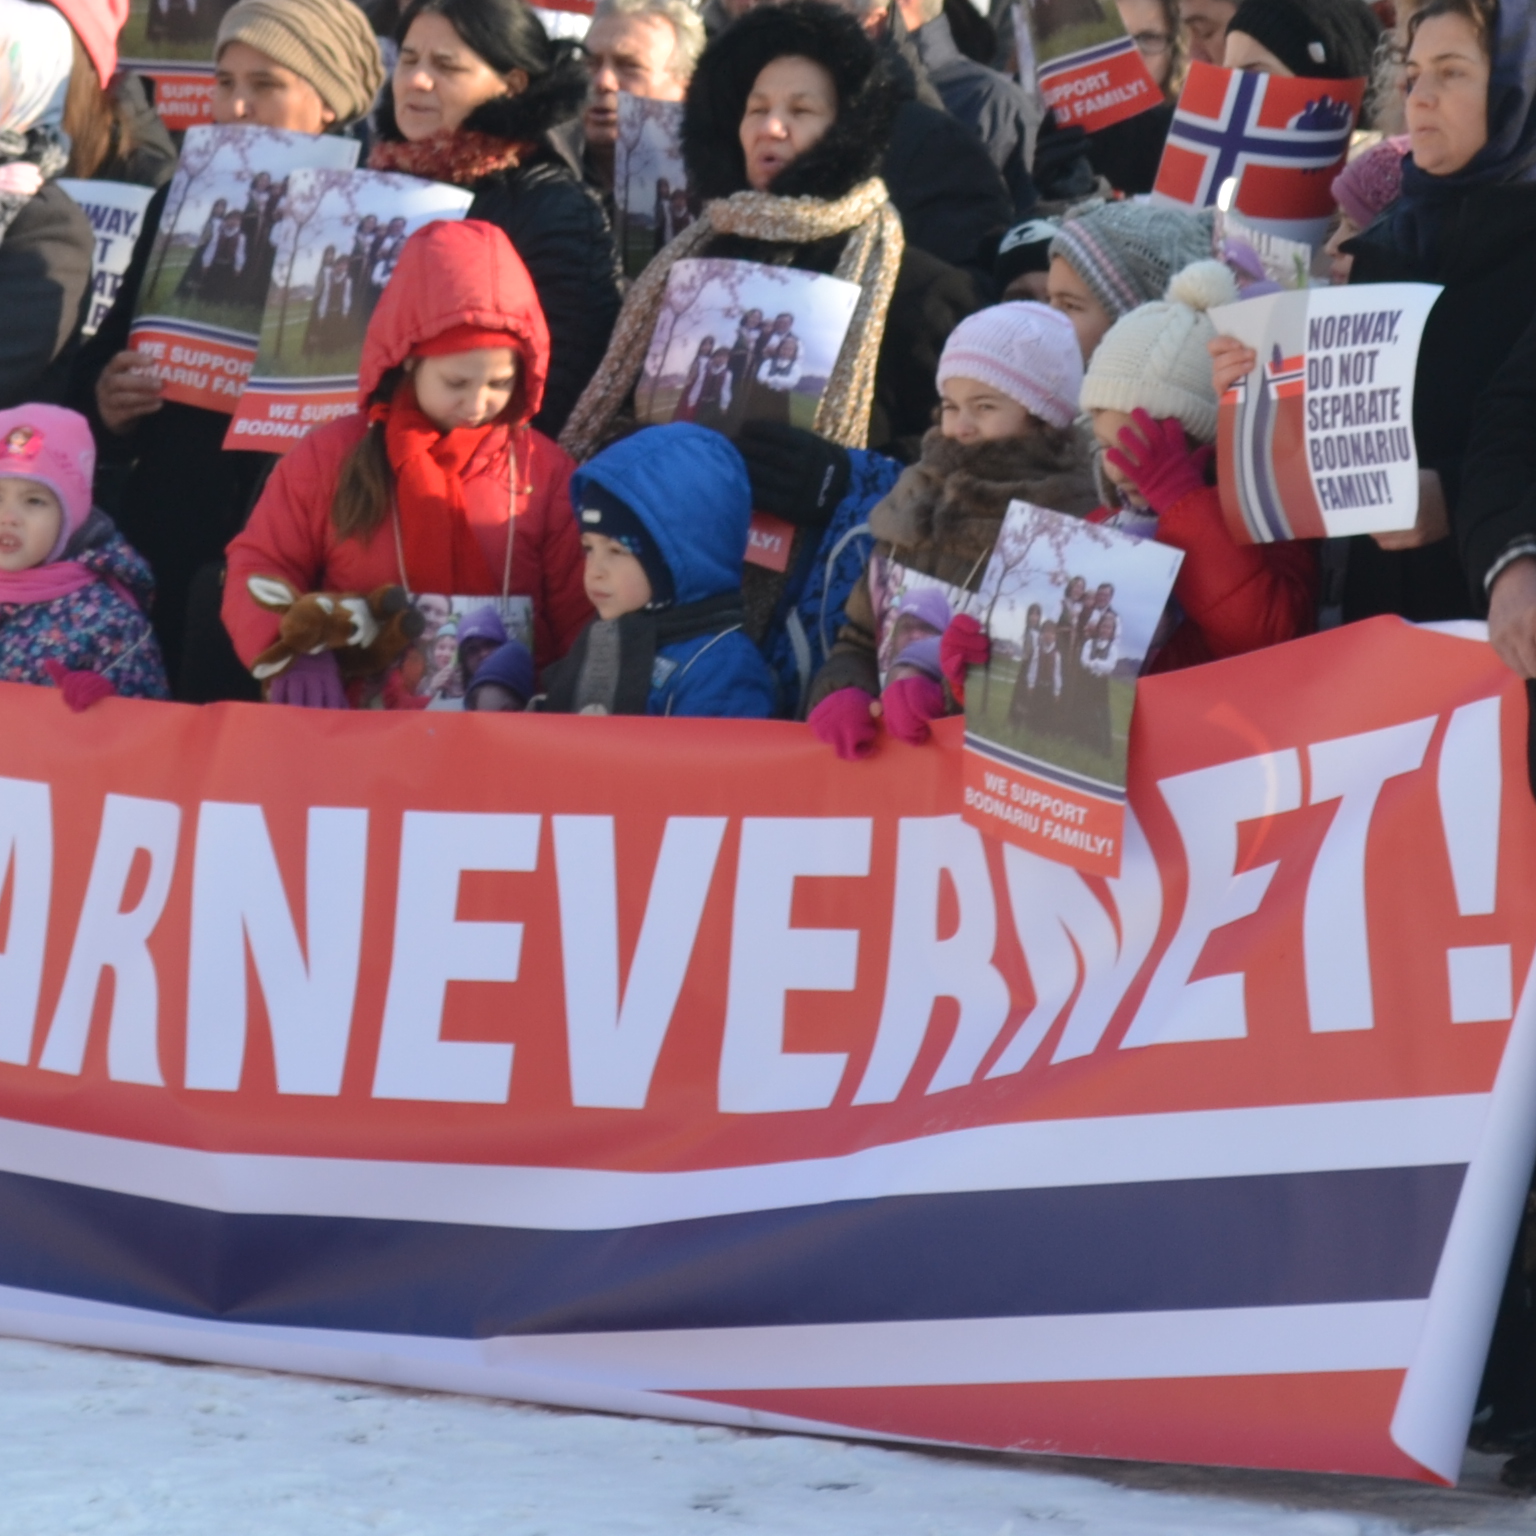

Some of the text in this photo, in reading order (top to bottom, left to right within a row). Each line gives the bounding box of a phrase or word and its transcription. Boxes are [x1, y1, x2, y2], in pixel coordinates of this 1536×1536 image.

[1073, 79, 1148, 119] FAMILY!
[1308, 310, 1403, 352] NORWAY,
[170, 345, 254, 377] SUPPOR
[1308, 349, 1379, 392] DO NOT
[233, 417, 311, 439] BODNA
[268, 403, 298, 420] WE
[1308, 386, 1401, 432] SEPARATE
[1309, 426, 1411, 472] BODNARIU
[1316, 469, 1394, 511] FAMILY!
[984, 771, 1088, 825] WE SUPPORT
[964, 786, 1114, 857] BODNARIU FAMILY!
